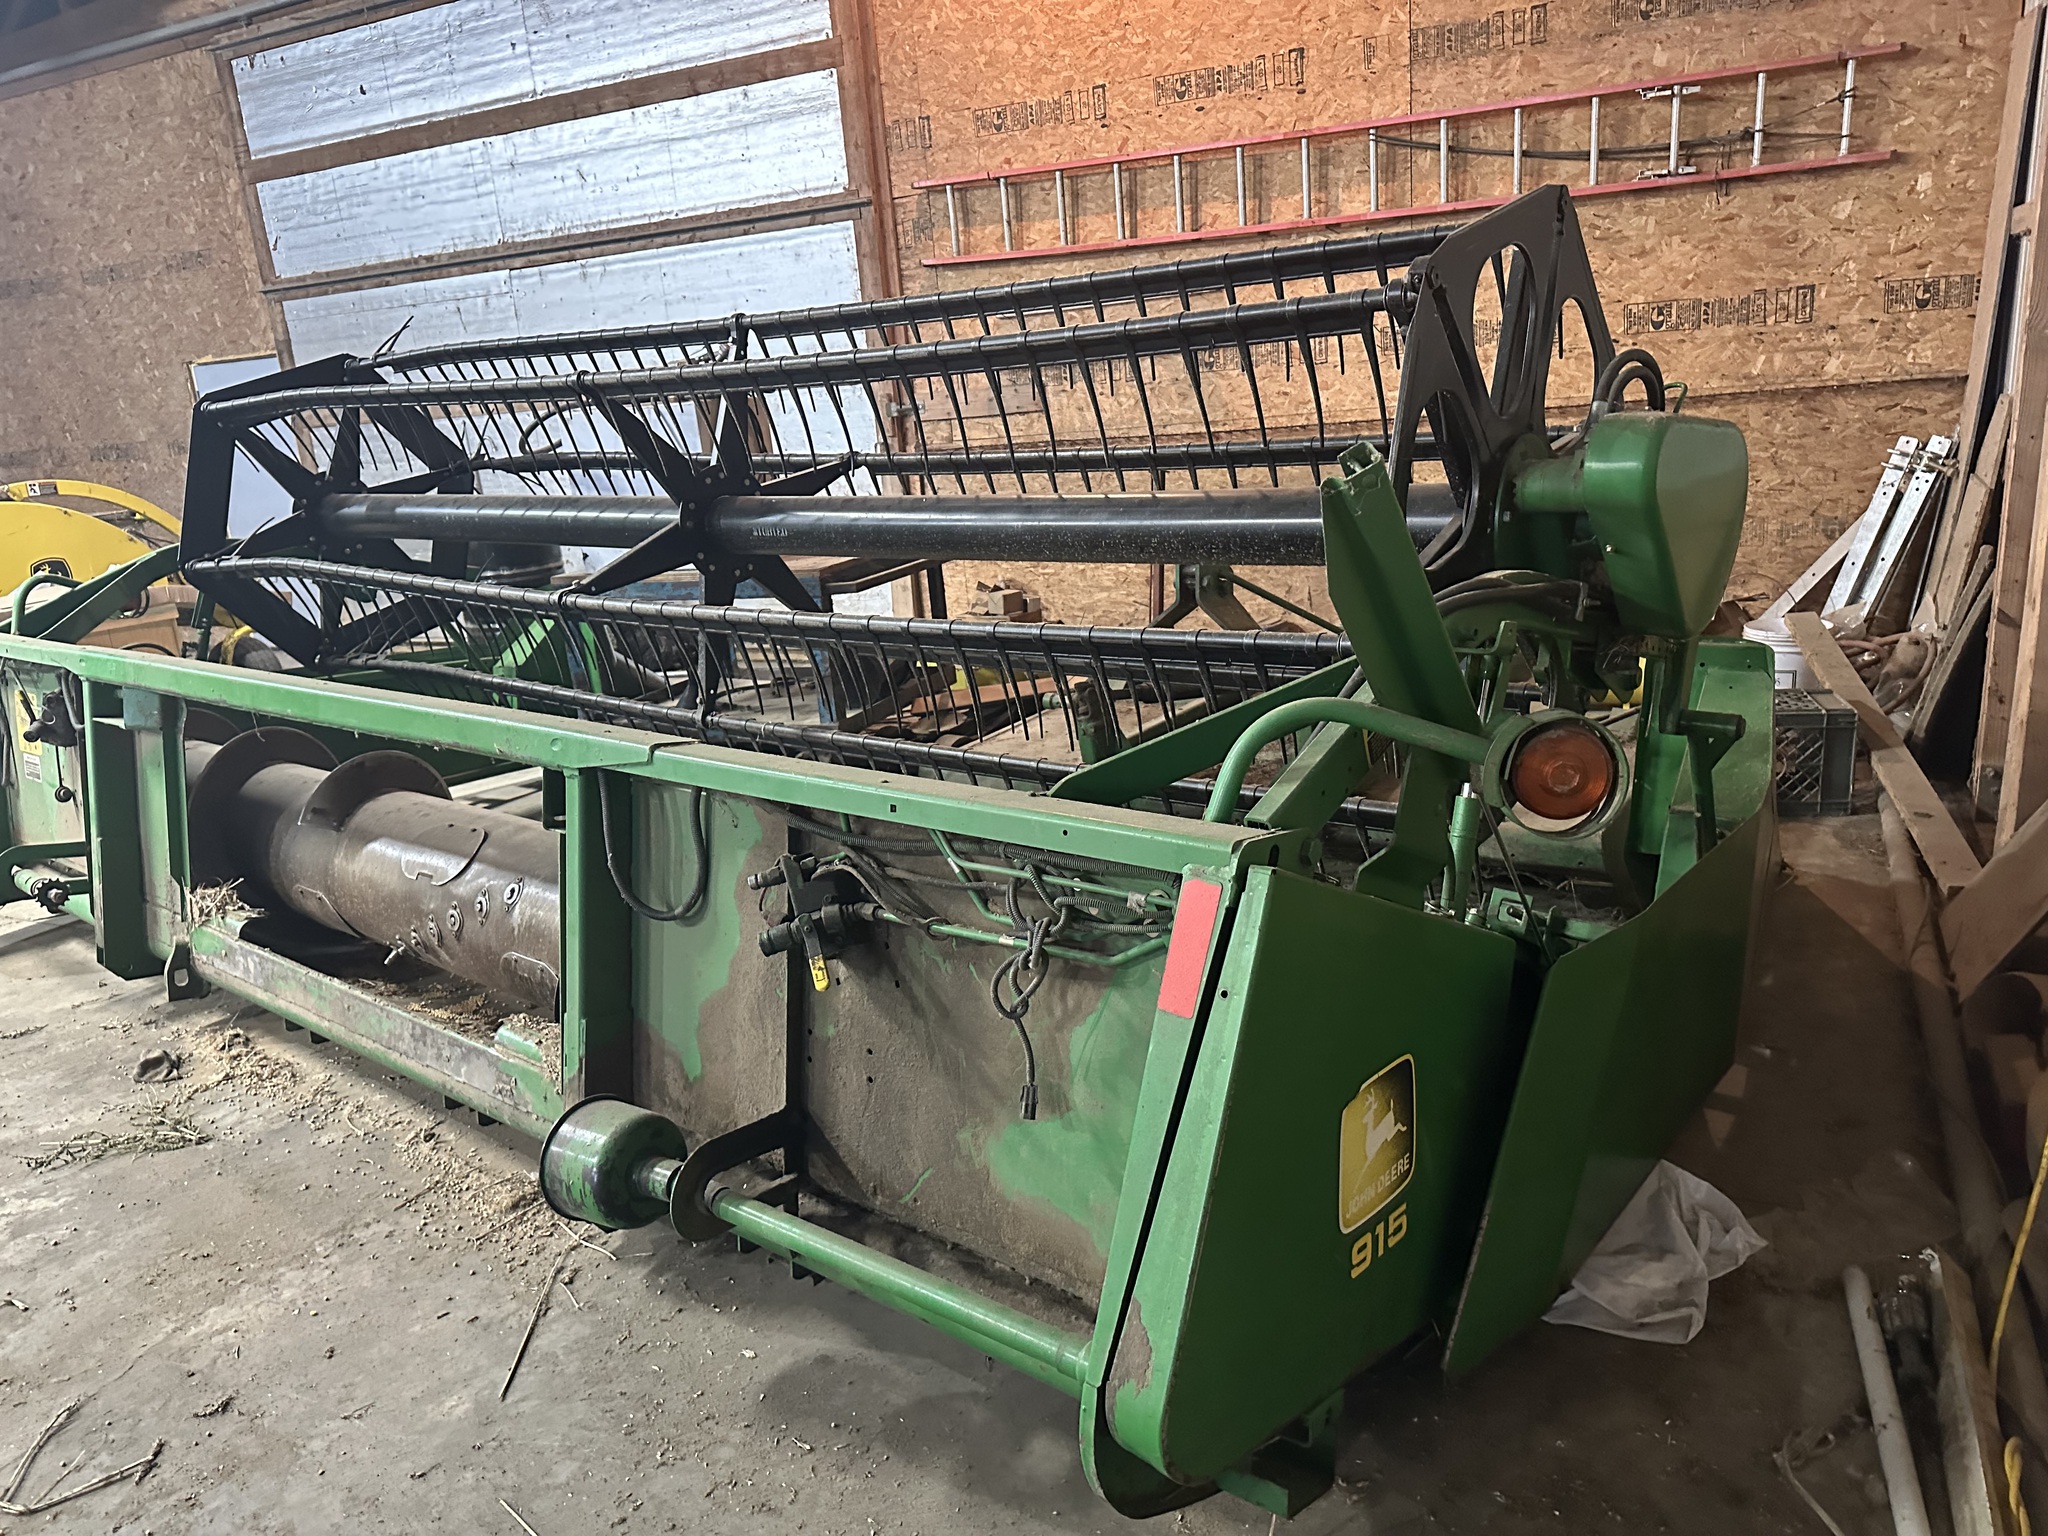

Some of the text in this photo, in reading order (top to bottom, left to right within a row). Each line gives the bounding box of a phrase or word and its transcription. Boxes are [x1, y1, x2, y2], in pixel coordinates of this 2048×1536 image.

[1411, 29, 1421, 59] grant
[1186, 73, 1195, 98] grant
[1931, 279, 1943, 308] grant
[1664, 302, 1675, 330] grant
[1702, 301, 1710, 326] APA
[1345, 1152, 1411, 1219] JOHN DEERE
[1350, 1202, 1408, 1279] 915
